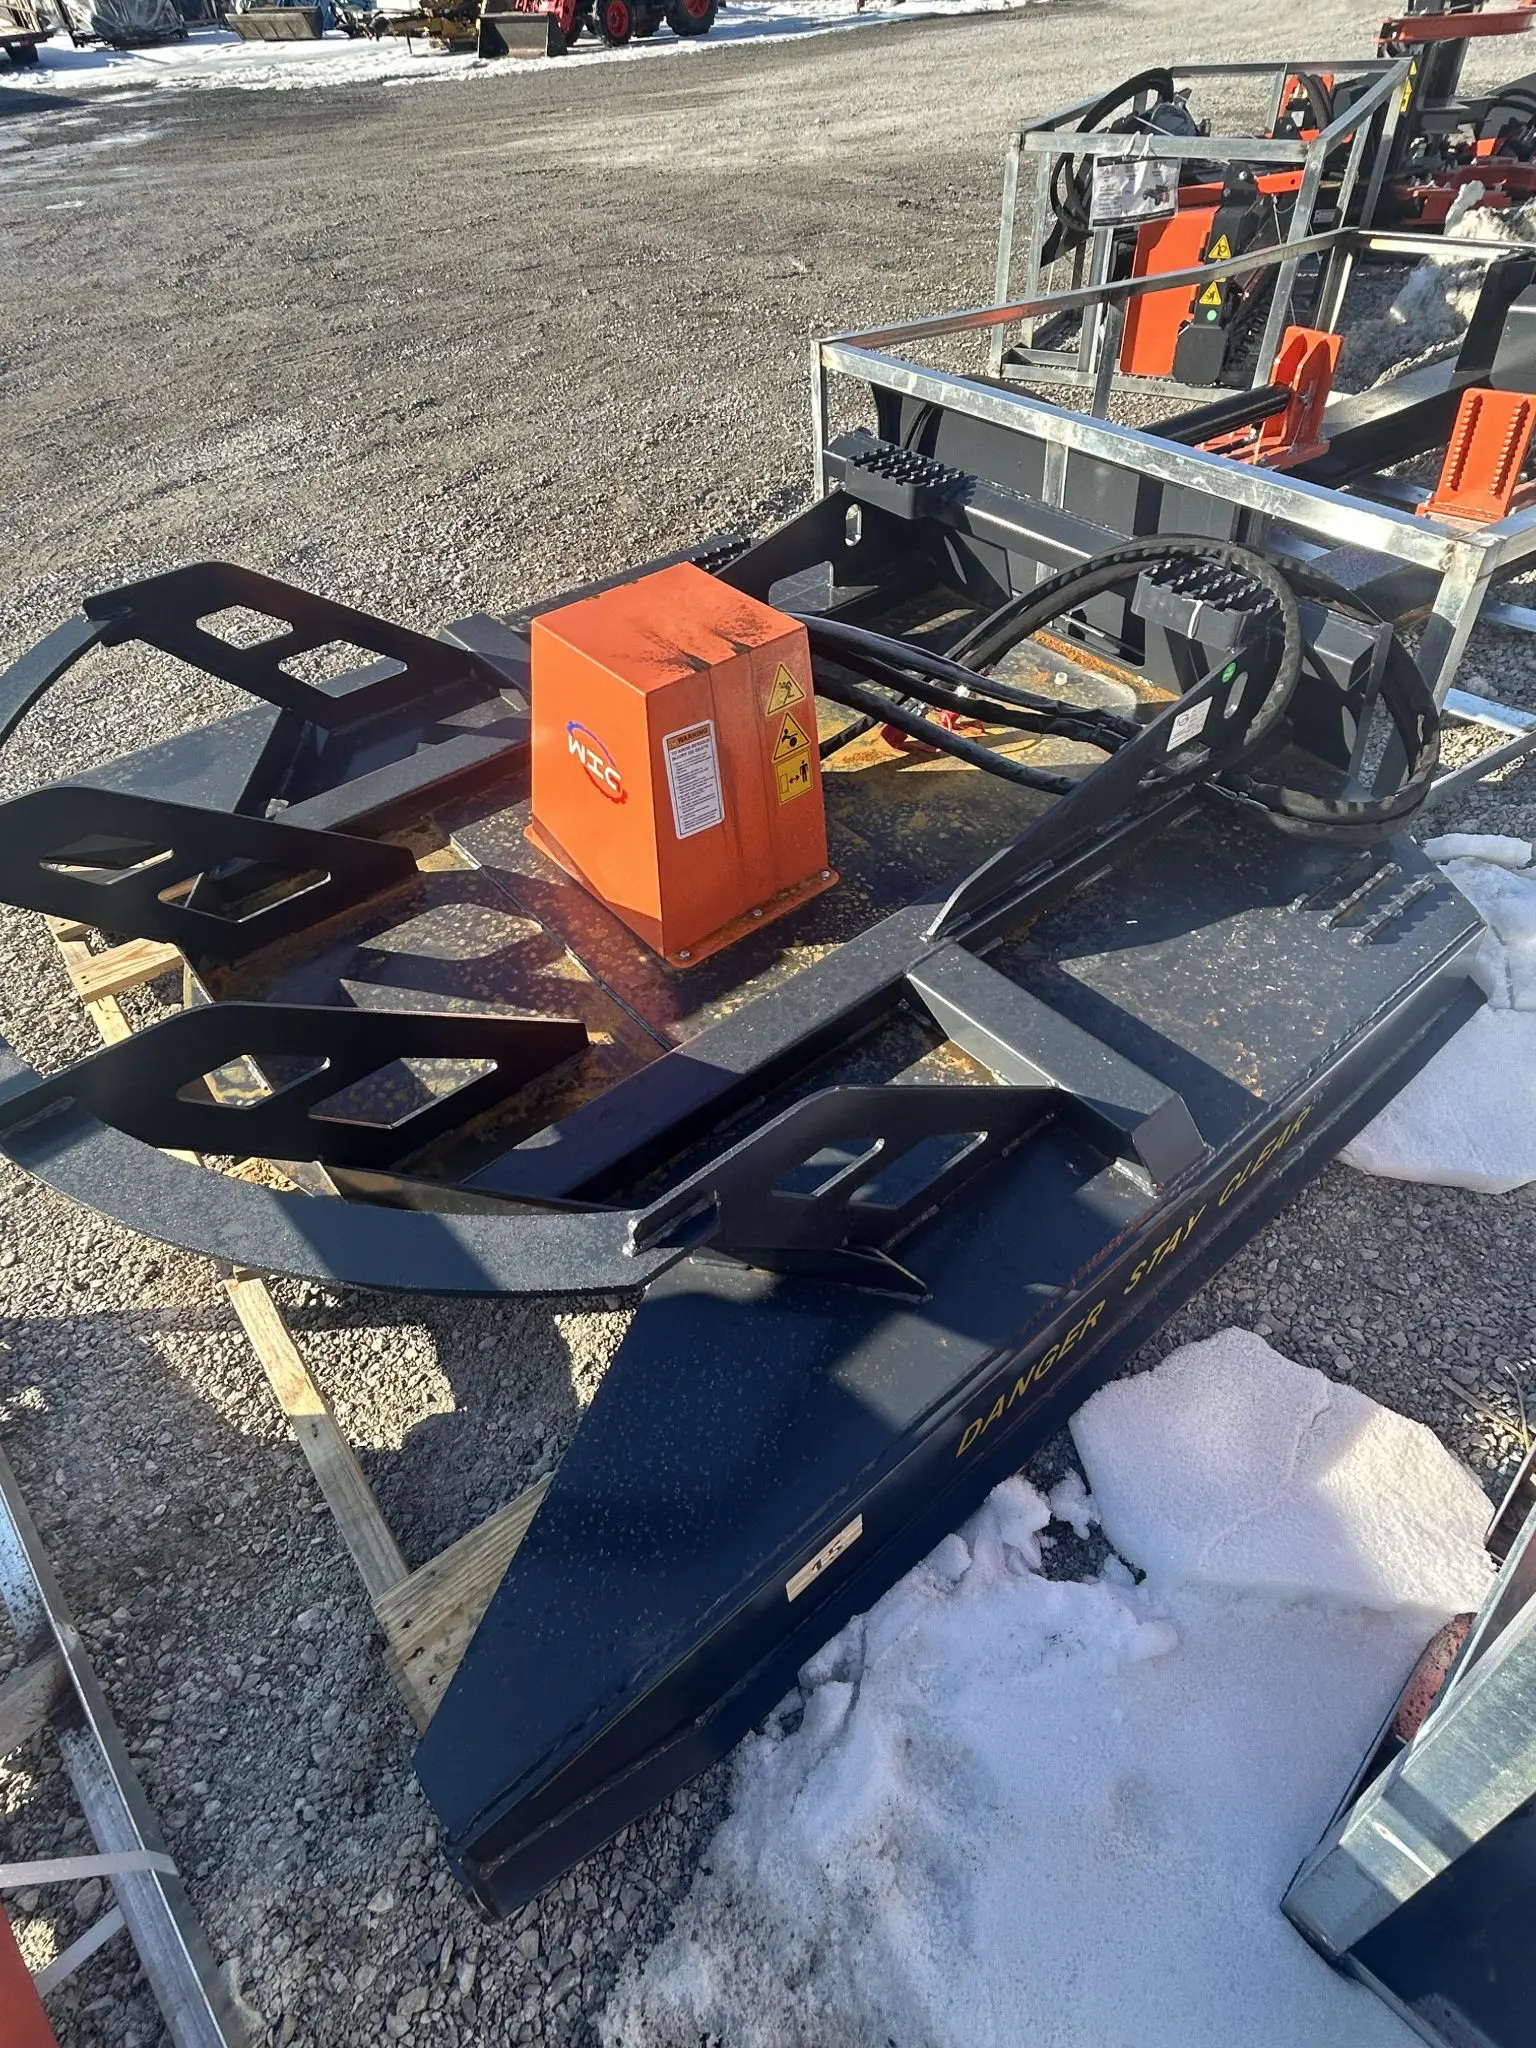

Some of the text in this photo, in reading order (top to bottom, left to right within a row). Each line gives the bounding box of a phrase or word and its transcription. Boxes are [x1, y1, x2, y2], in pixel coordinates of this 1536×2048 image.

[678, 727, 708, 744] WARNING
[956, 1104, 1312, 1458] DANGER STAY CLEAR
